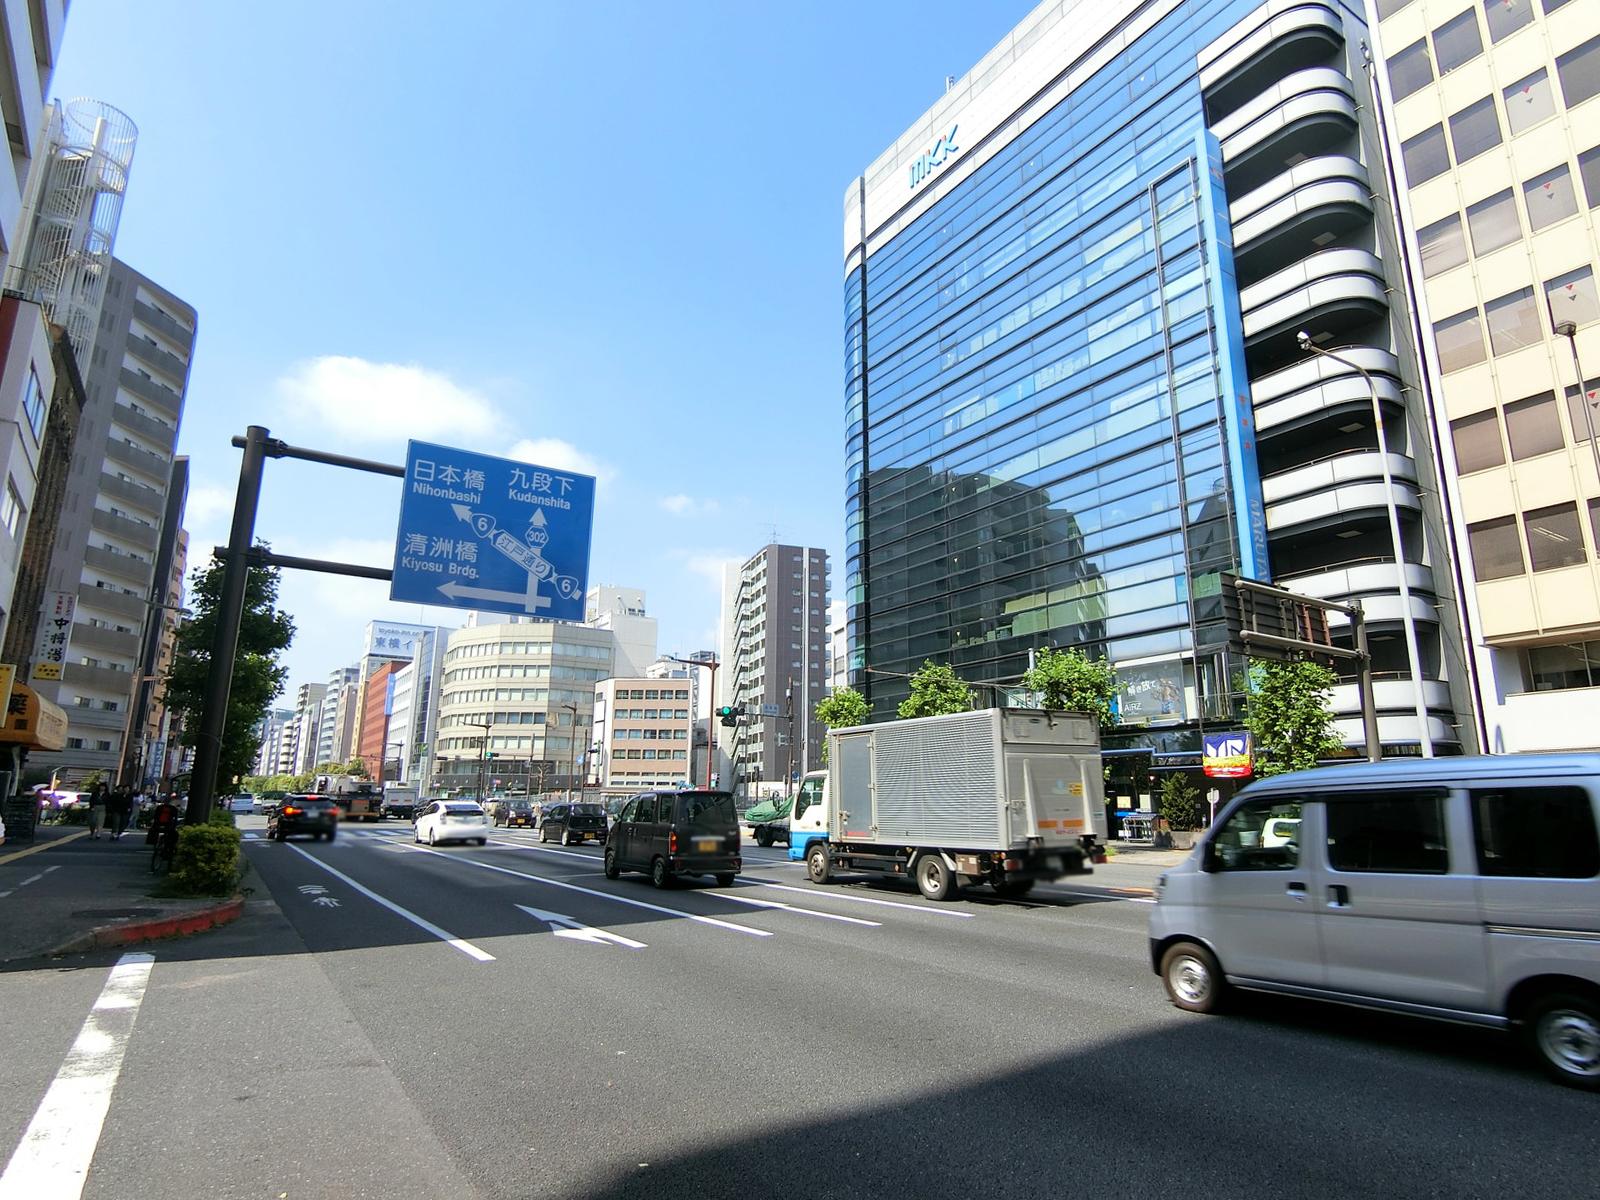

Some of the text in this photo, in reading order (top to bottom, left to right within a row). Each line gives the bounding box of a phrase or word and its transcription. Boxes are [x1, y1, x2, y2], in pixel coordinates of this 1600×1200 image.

[413, 459, 486, 492] 日本橋
[508, 467, 575, 496] 九段下
[412, 482, 481, 505] Nihonbashi
[508, 488, 571, 510] Kudanshita
[477, 517, 488, 531] 6
[402, 532, 479, 563] 清洲橋
[529, 531, 546, 544] 302
[497, 535, 547, 574] 江戸通り
[401, 556, 480, 579] Kiyosu Brdg.
[561, 579, 571, 593] 6
